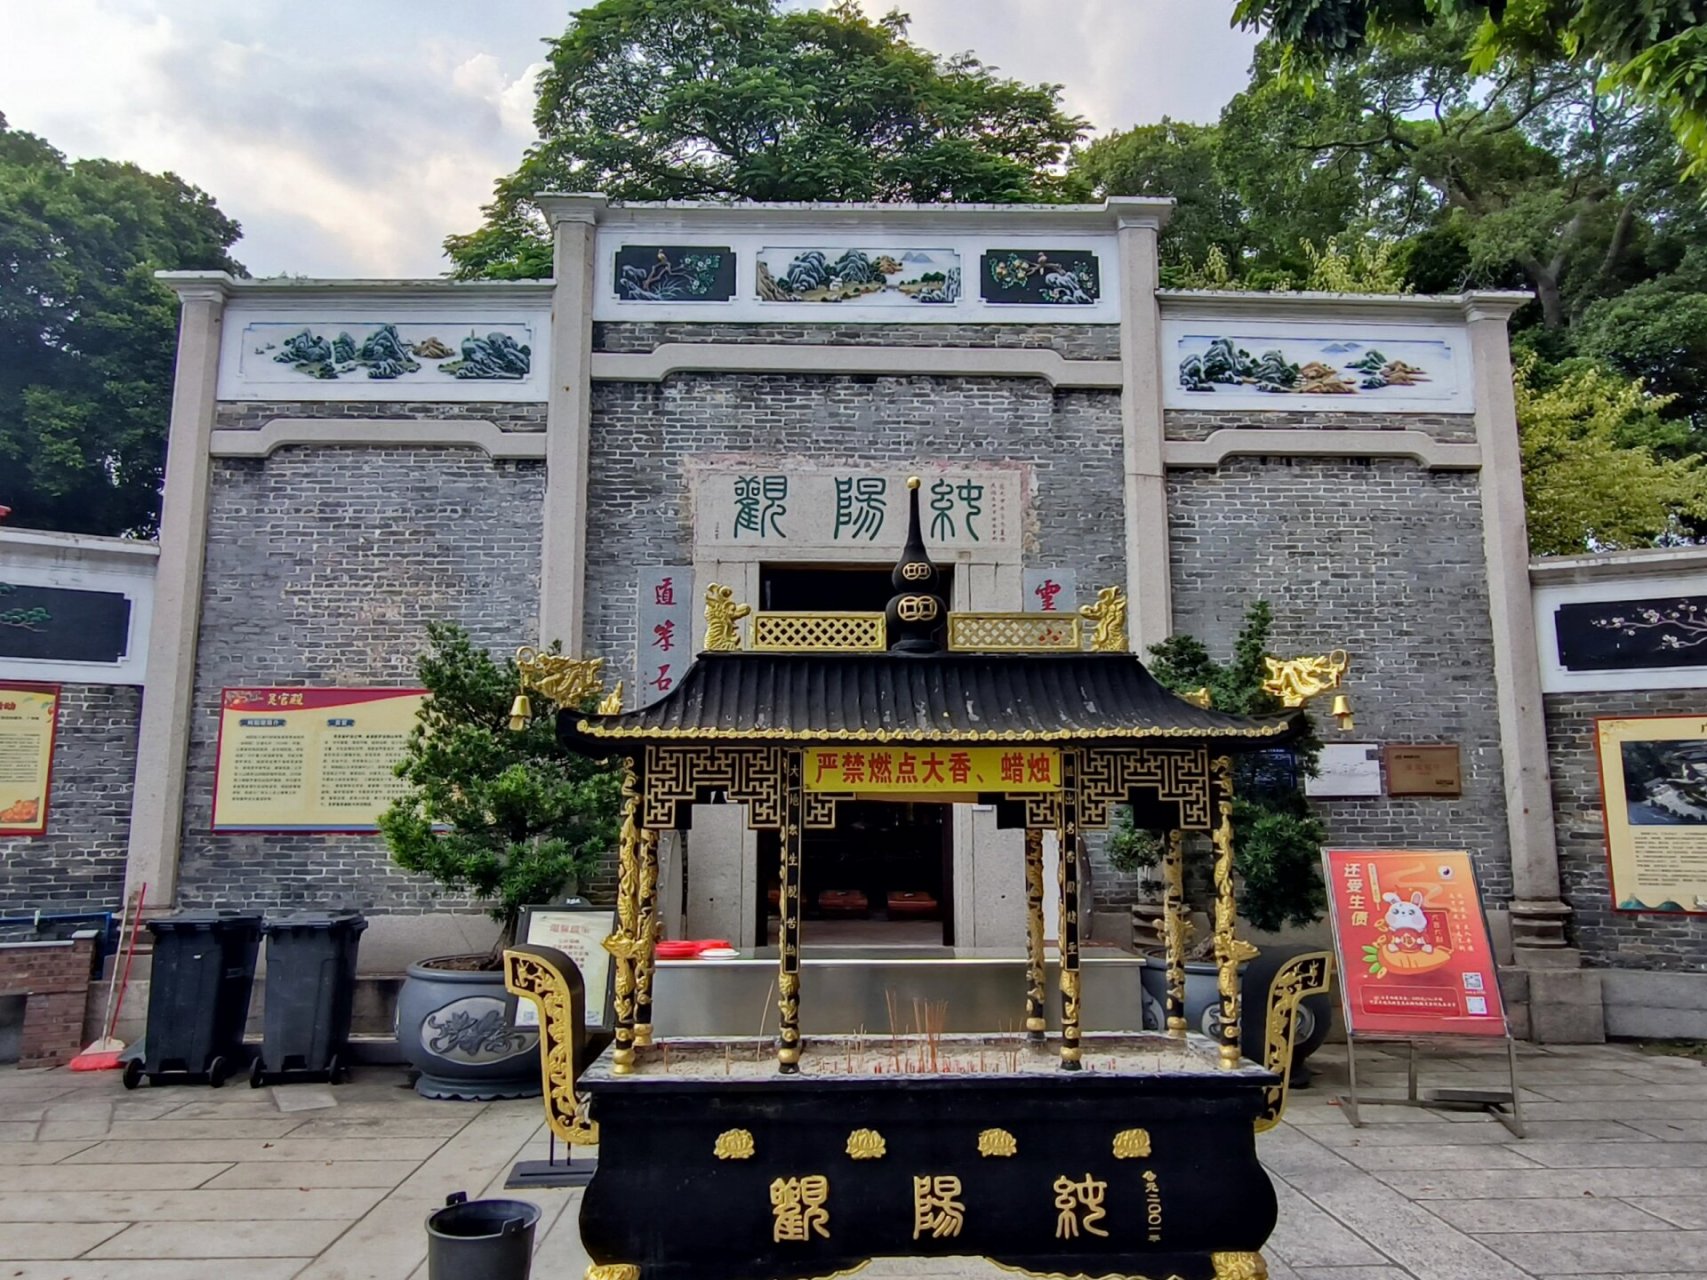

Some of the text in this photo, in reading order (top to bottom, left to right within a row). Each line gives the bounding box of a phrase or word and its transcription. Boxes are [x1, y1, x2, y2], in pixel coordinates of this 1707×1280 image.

[816, 752, 1051, 784] 严禁燃点大香、蜡烛
[1344, 863, 1369, 926] 还受生债
